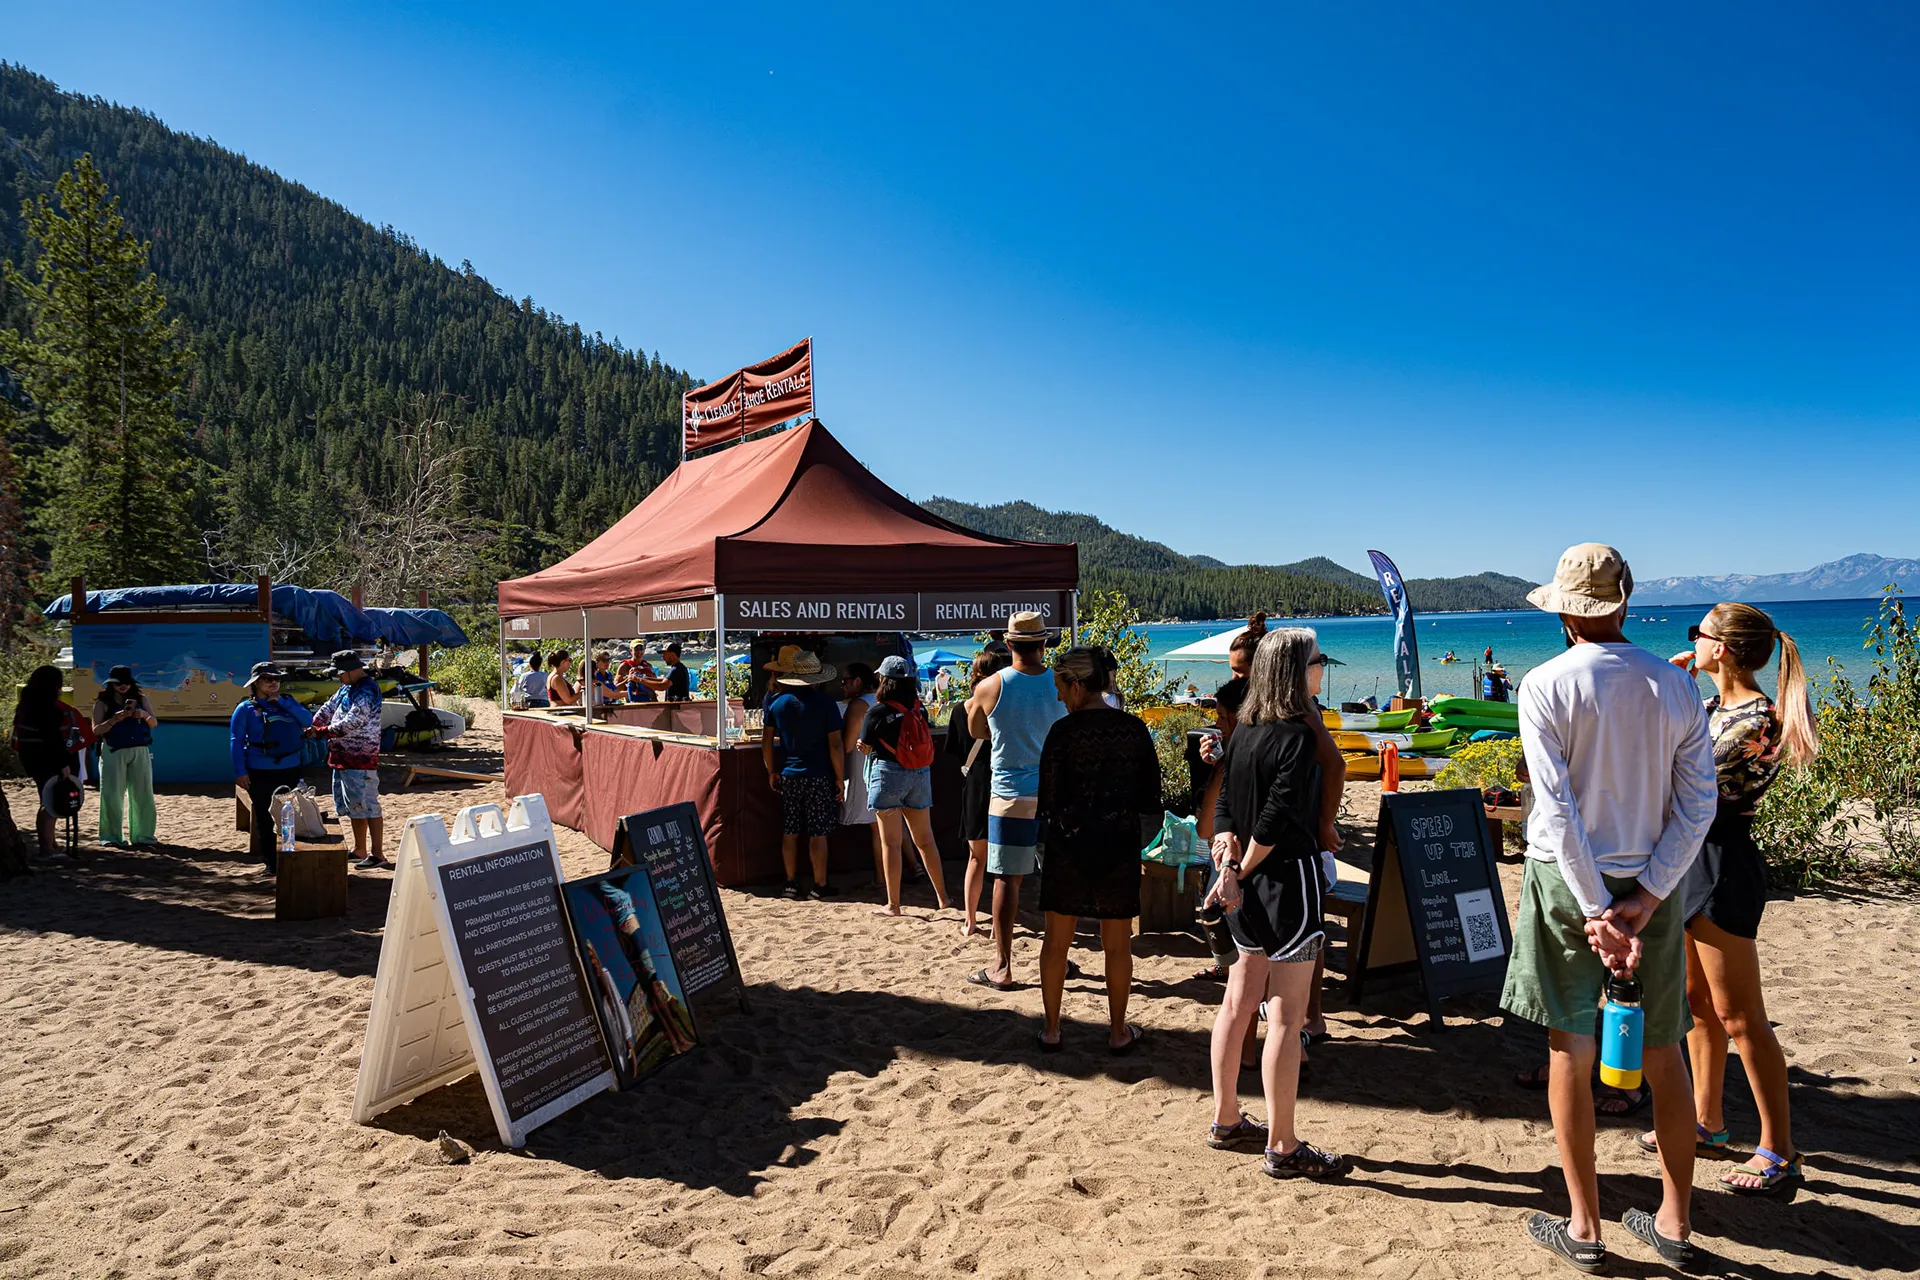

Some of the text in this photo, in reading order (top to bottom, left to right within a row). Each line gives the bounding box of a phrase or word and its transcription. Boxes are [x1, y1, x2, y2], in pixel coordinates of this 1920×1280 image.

[704, 372, 806, 423] CLEARLY TAHOE RENTALS
[652, 602, 698, 622] INFORMATION
[739, 600, 906, 620] SALES AND RENTALS
[935, 603, 987, 620] RENTAL
[1410, 814, 1453, 840] SPEED
[449, 848, 544, 880] RENTAL INFORMATION
[1424, 841, 1477, 860] UP THE
[453, 876, 553, 911] RENTAL PRIMARY MUST BE OVER 18
[464, 904, 558, 940] AND CREDIT CARD FOR CHECK-IN
[465, 895, 551, 927] PRIMARY MUST HAVE VALID ID
[474, 947, 486, 956] ALL
[486, 932, 528, 952] PARTICIPANTS
[527, 926, 544, 938] MUST
[543, 924, 552, 932] BE
[477, 937, 564, 974] GUESTS MUST BE 12 YEARS OLD
[501, 954, 550, 977] TO PADDLE SOLO
[487, 963, 571, 1002] PARTICIPANTS UNDER 18 MUST
[487, 1006, 497, 1015] BE
[497, 990, 534, 1012] SUPERVISED
[534, 988, 542, 996] BY
[542, 984, 552, 993] AN
[551, 977, 570, 991] ADULT
[499, 990, 578, 1032] ALL GUESTS MUST COMPLETE
[517, 1006, 569, 1035] LIABILITY WAIVERS
[496, 1014, 595, 1066] PARTICIPANTS MUST ATTEND SAFETY
[502, 1062, 520, 1076] BRIEF
[520, 1055, 535, 1066] AND
[553, 1037, 574, 1052] WITHIN
[573, 1024, 598, 1042] DEFINED
[501, 1074, 525, 1090] RENTAL
[524, 1053, 562, 1076] BOUNDARIES
